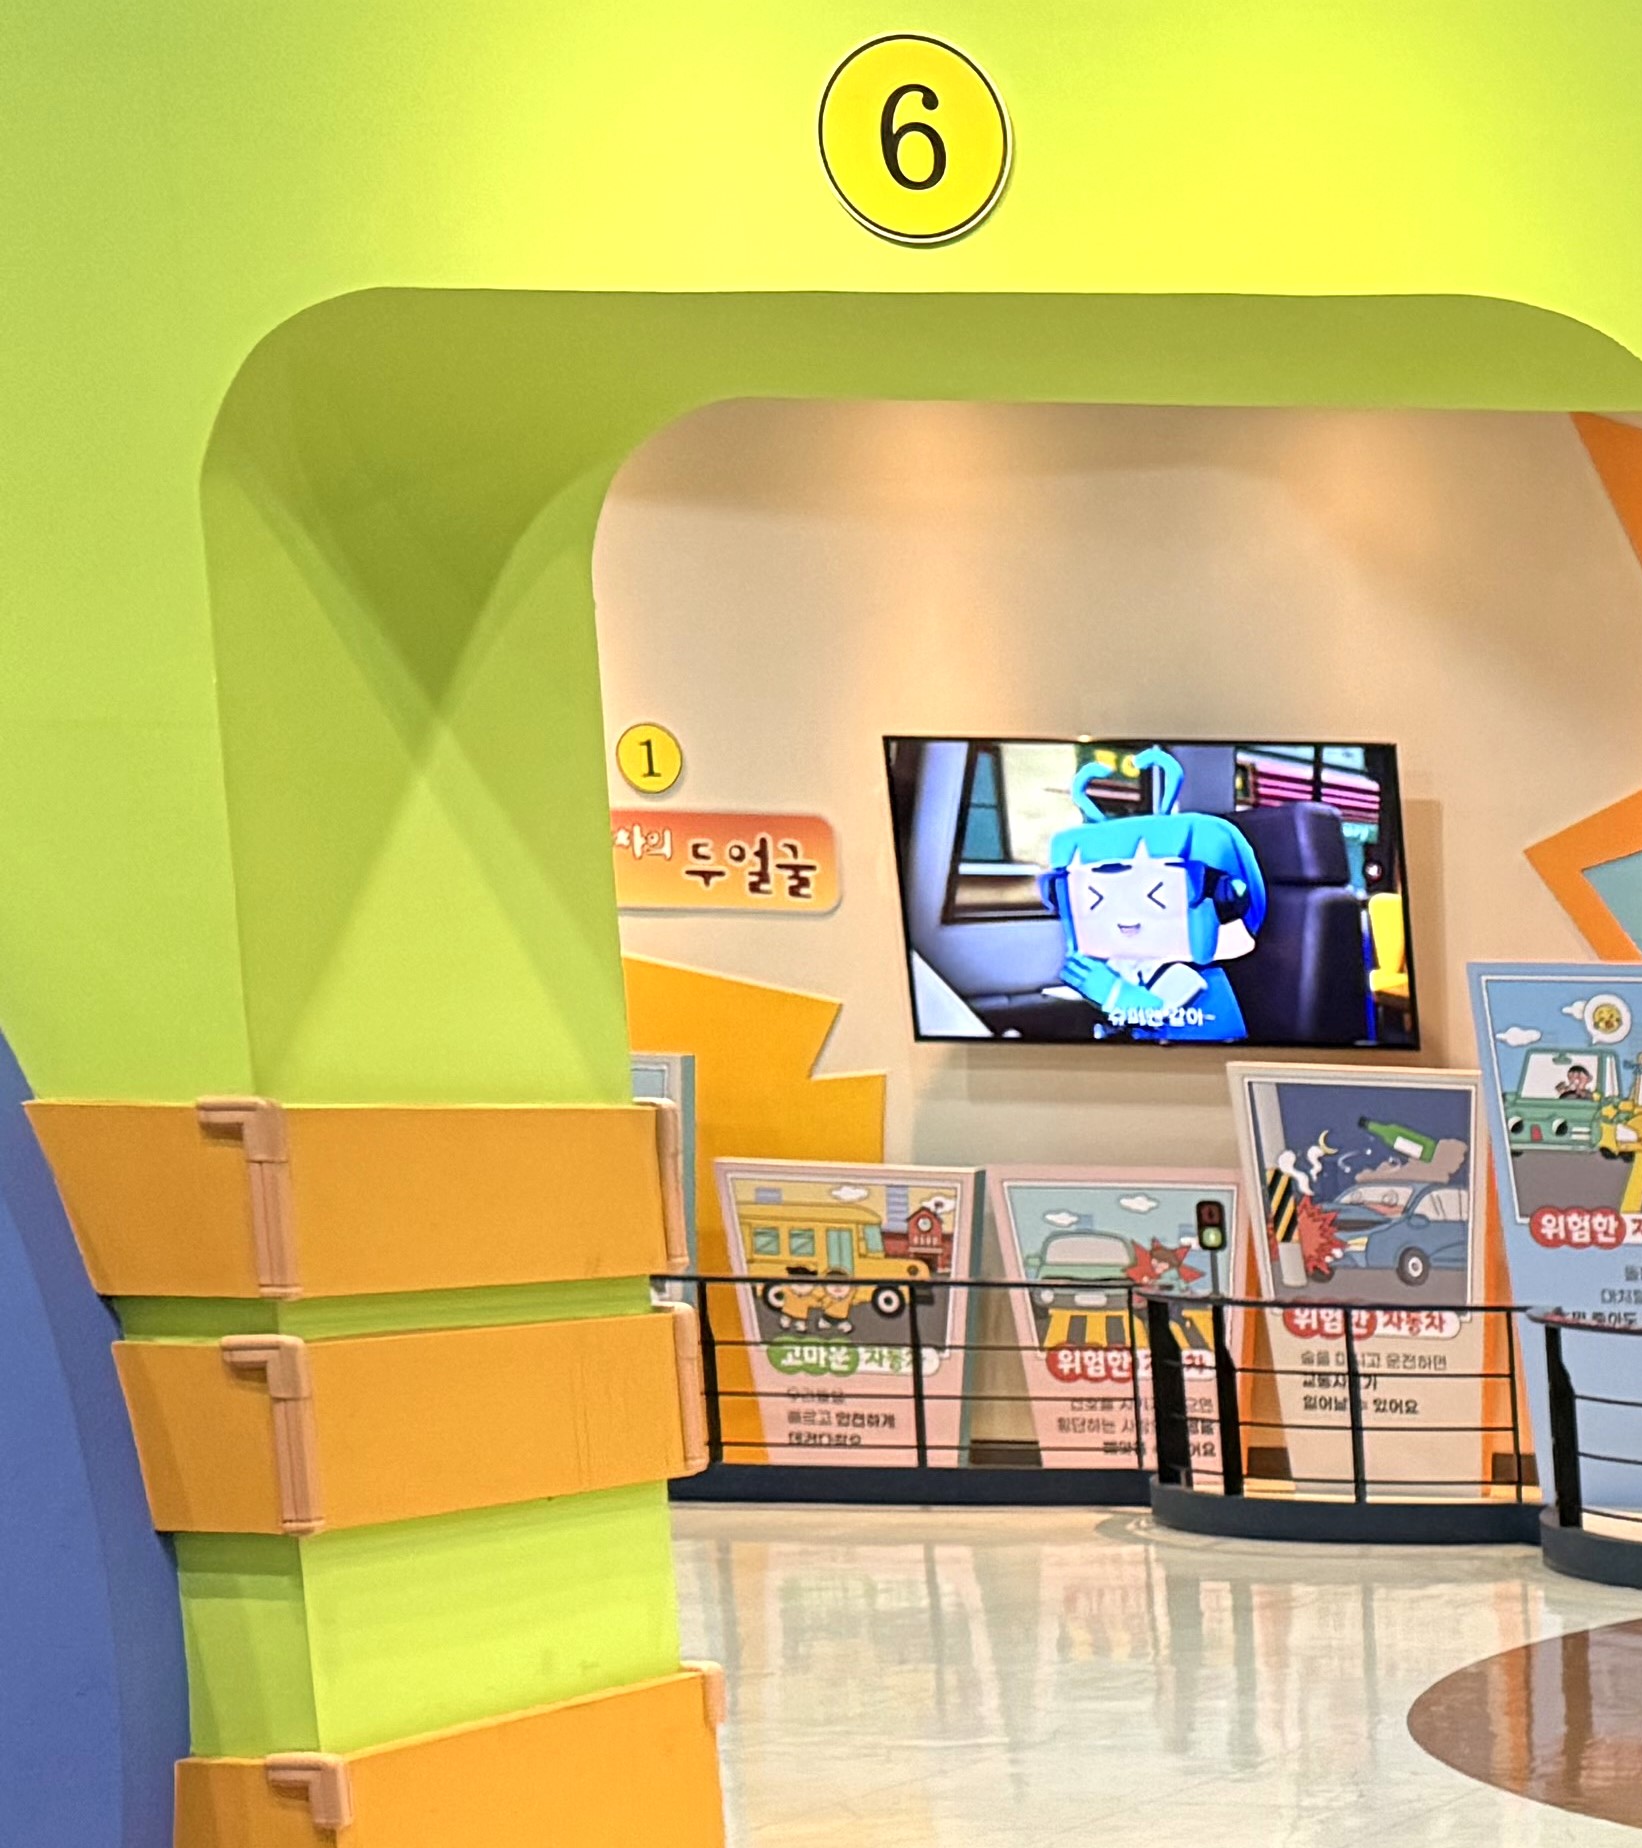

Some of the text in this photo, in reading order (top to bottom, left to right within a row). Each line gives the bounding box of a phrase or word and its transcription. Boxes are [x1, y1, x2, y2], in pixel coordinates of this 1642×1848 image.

[881, 84, 947, 190] 6
[639, 739, 661, 778] 1
[1540, 1212, 1620, 1244] 위험한
[780, 1344, 852, 1370] 고마운
[1056, 1349, 1133, 1379] 위험한
